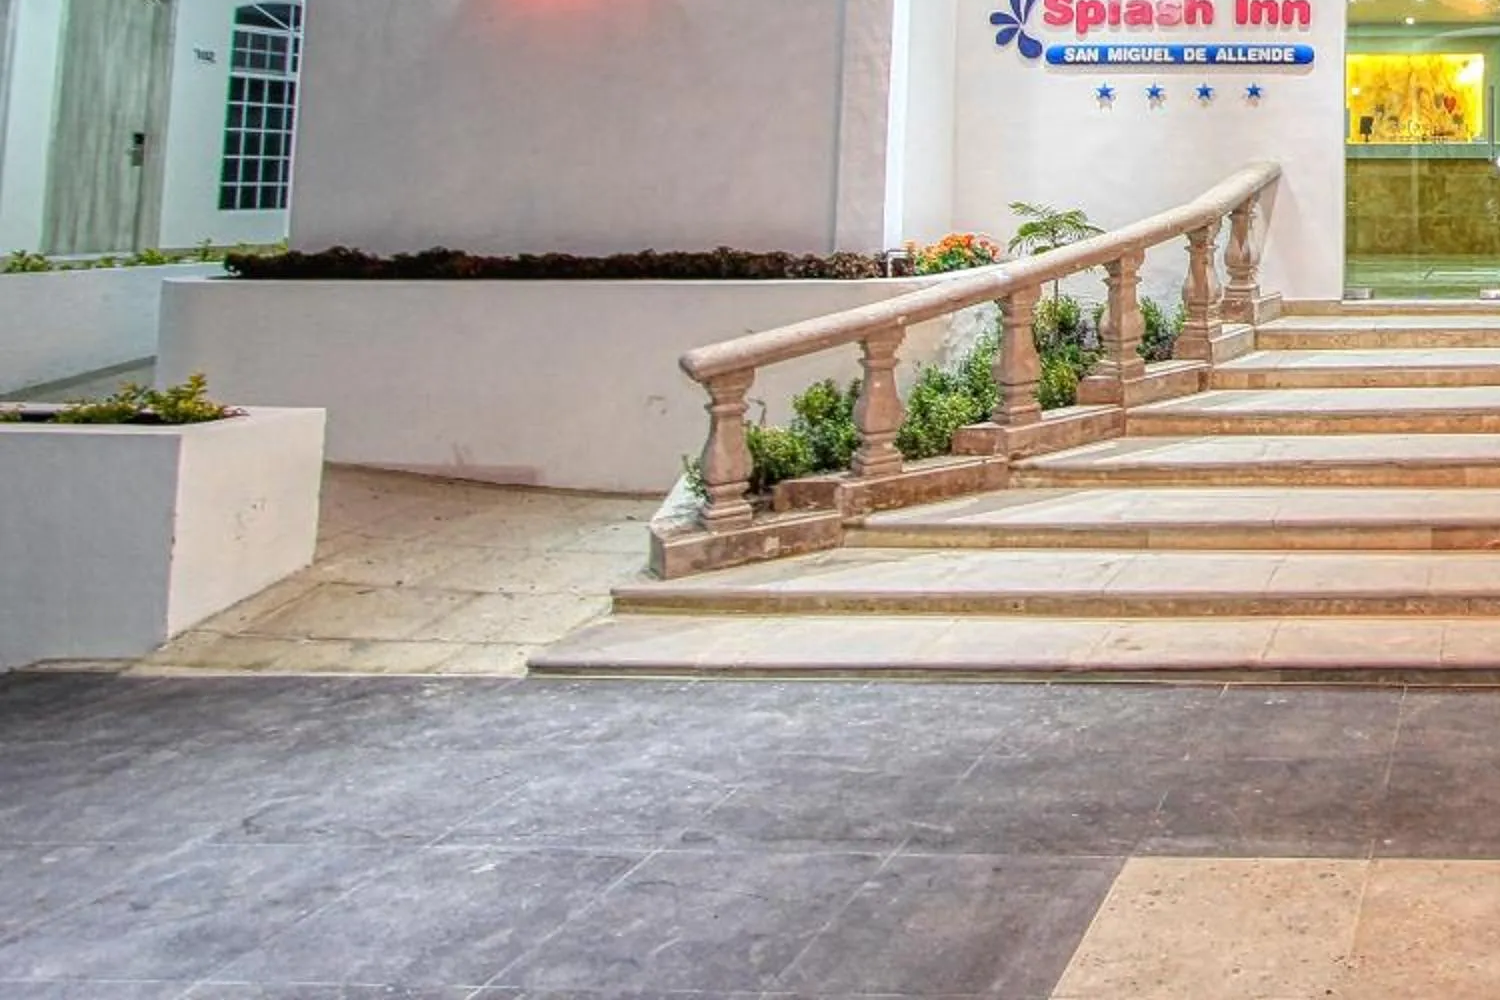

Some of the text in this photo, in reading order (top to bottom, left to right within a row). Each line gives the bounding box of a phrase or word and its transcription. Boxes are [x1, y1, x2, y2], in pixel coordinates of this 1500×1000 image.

[1064, 47, 1295, 62] SAN MIGUEL DE ALLENDE
